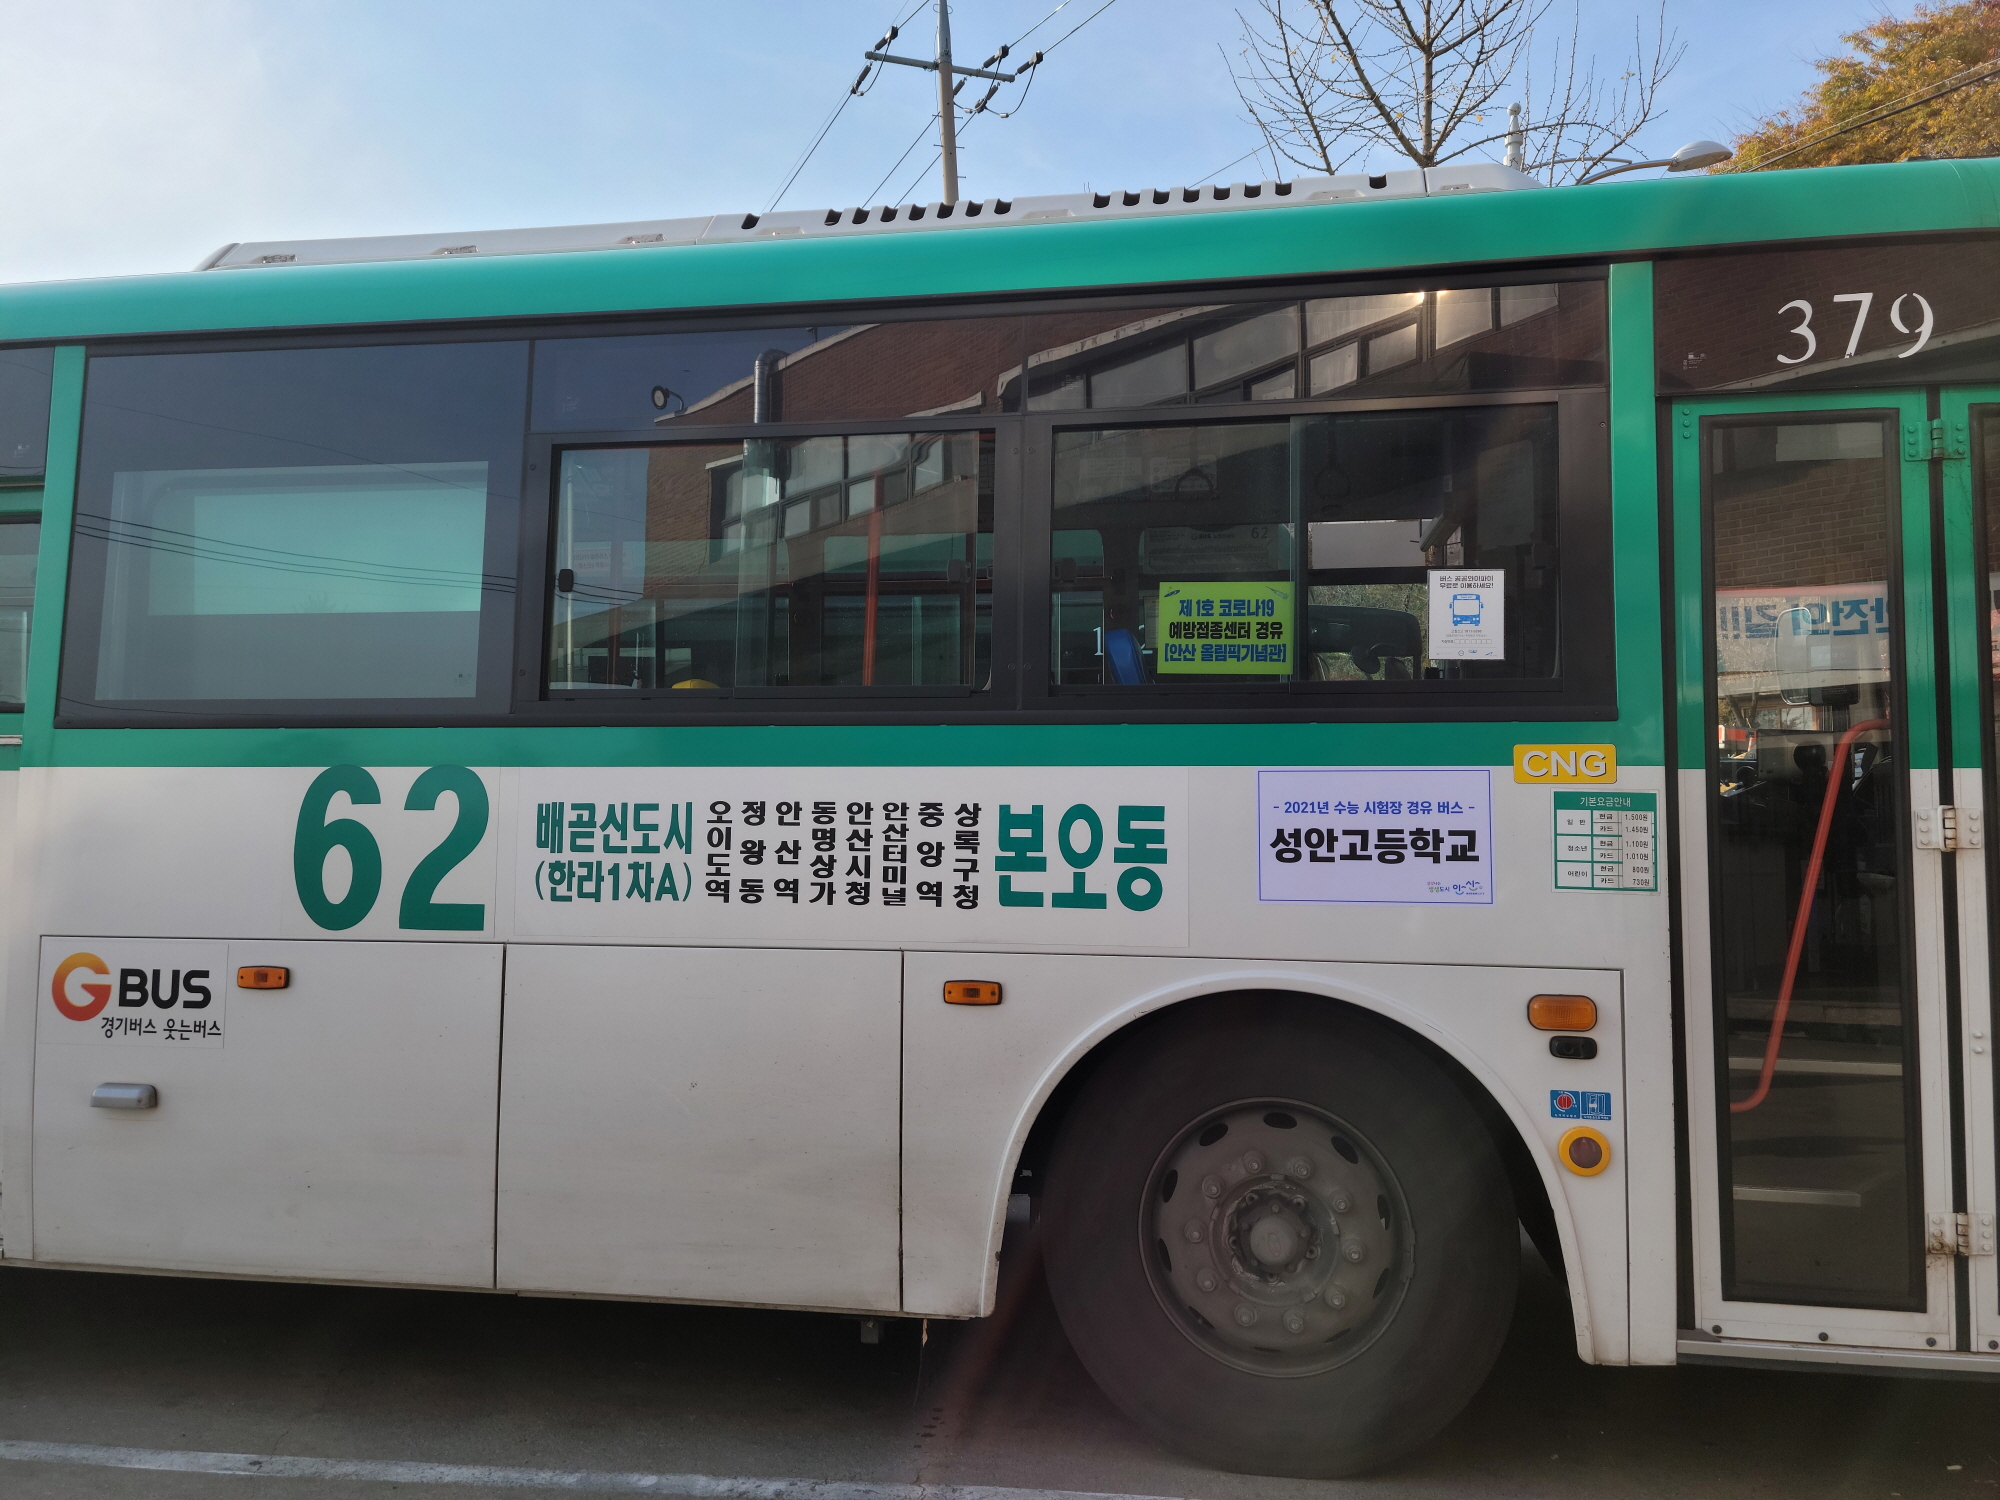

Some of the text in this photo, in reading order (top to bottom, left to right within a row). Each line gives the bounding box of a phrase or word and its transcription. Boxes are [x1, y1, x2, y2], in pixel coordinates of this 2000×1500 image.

[1777, 292, 1934, 364] 379
[1251, 527, 1269, 540] 62
[1179, 599, 1275, 617] 제 1호 코로나19
[1169, 621, 1283, 639] 예방접종센터 경유
[1164, 643, 1287, 663] [안산 올림픽기념관]
[1522, 750, 1607, 777] CNG
[1284, 801, 1330, 815] 2021년
[1334, 801, 1359, 815] 수능
[1364, 801, 1403, 815] 시험장
[1406, 801, 1433, 815] 경유
[1437, 801, 1464, 815] 버스
[1580, 796, 1631, 808] 기본요금안내
[536, 801, 693, 854] 배곧신도시
[1625, 813, 1648, 822] 1.500원
[1625, 826, 1649, 834] 1.450원
[294, 764, 489, 931] 62
[705, 800, 733, 903] 오이도역
[739, 801, 766, 905] 정왕동
[773, 801, 803, 904] 안산역
[809, 801, 837, 905] 동명상가
[845, 802, 874, 906] 안산시청
[882, 802, 909, 907] 안산터미널
[916, 802, 945, 908] 중앙역
[952, 802, 982, 910] 상록구청
[994, 803, 1168, 912] 본오동
[1270, 828, 1480, 864] 성안고등학교
[1625, 840, 1649, 849] 1.100원
[1625, 853, 1649, 861] 1.010원
[535, 860, 692, 903] (한라1차A)
[1567, 870, 1588, 878] 어린이
[1632, 866, 1649, 874] 800원
[1632, 878, 1650, 886] 730원
[101, 1016, 222, 1040] 경기버스 웃는버스
